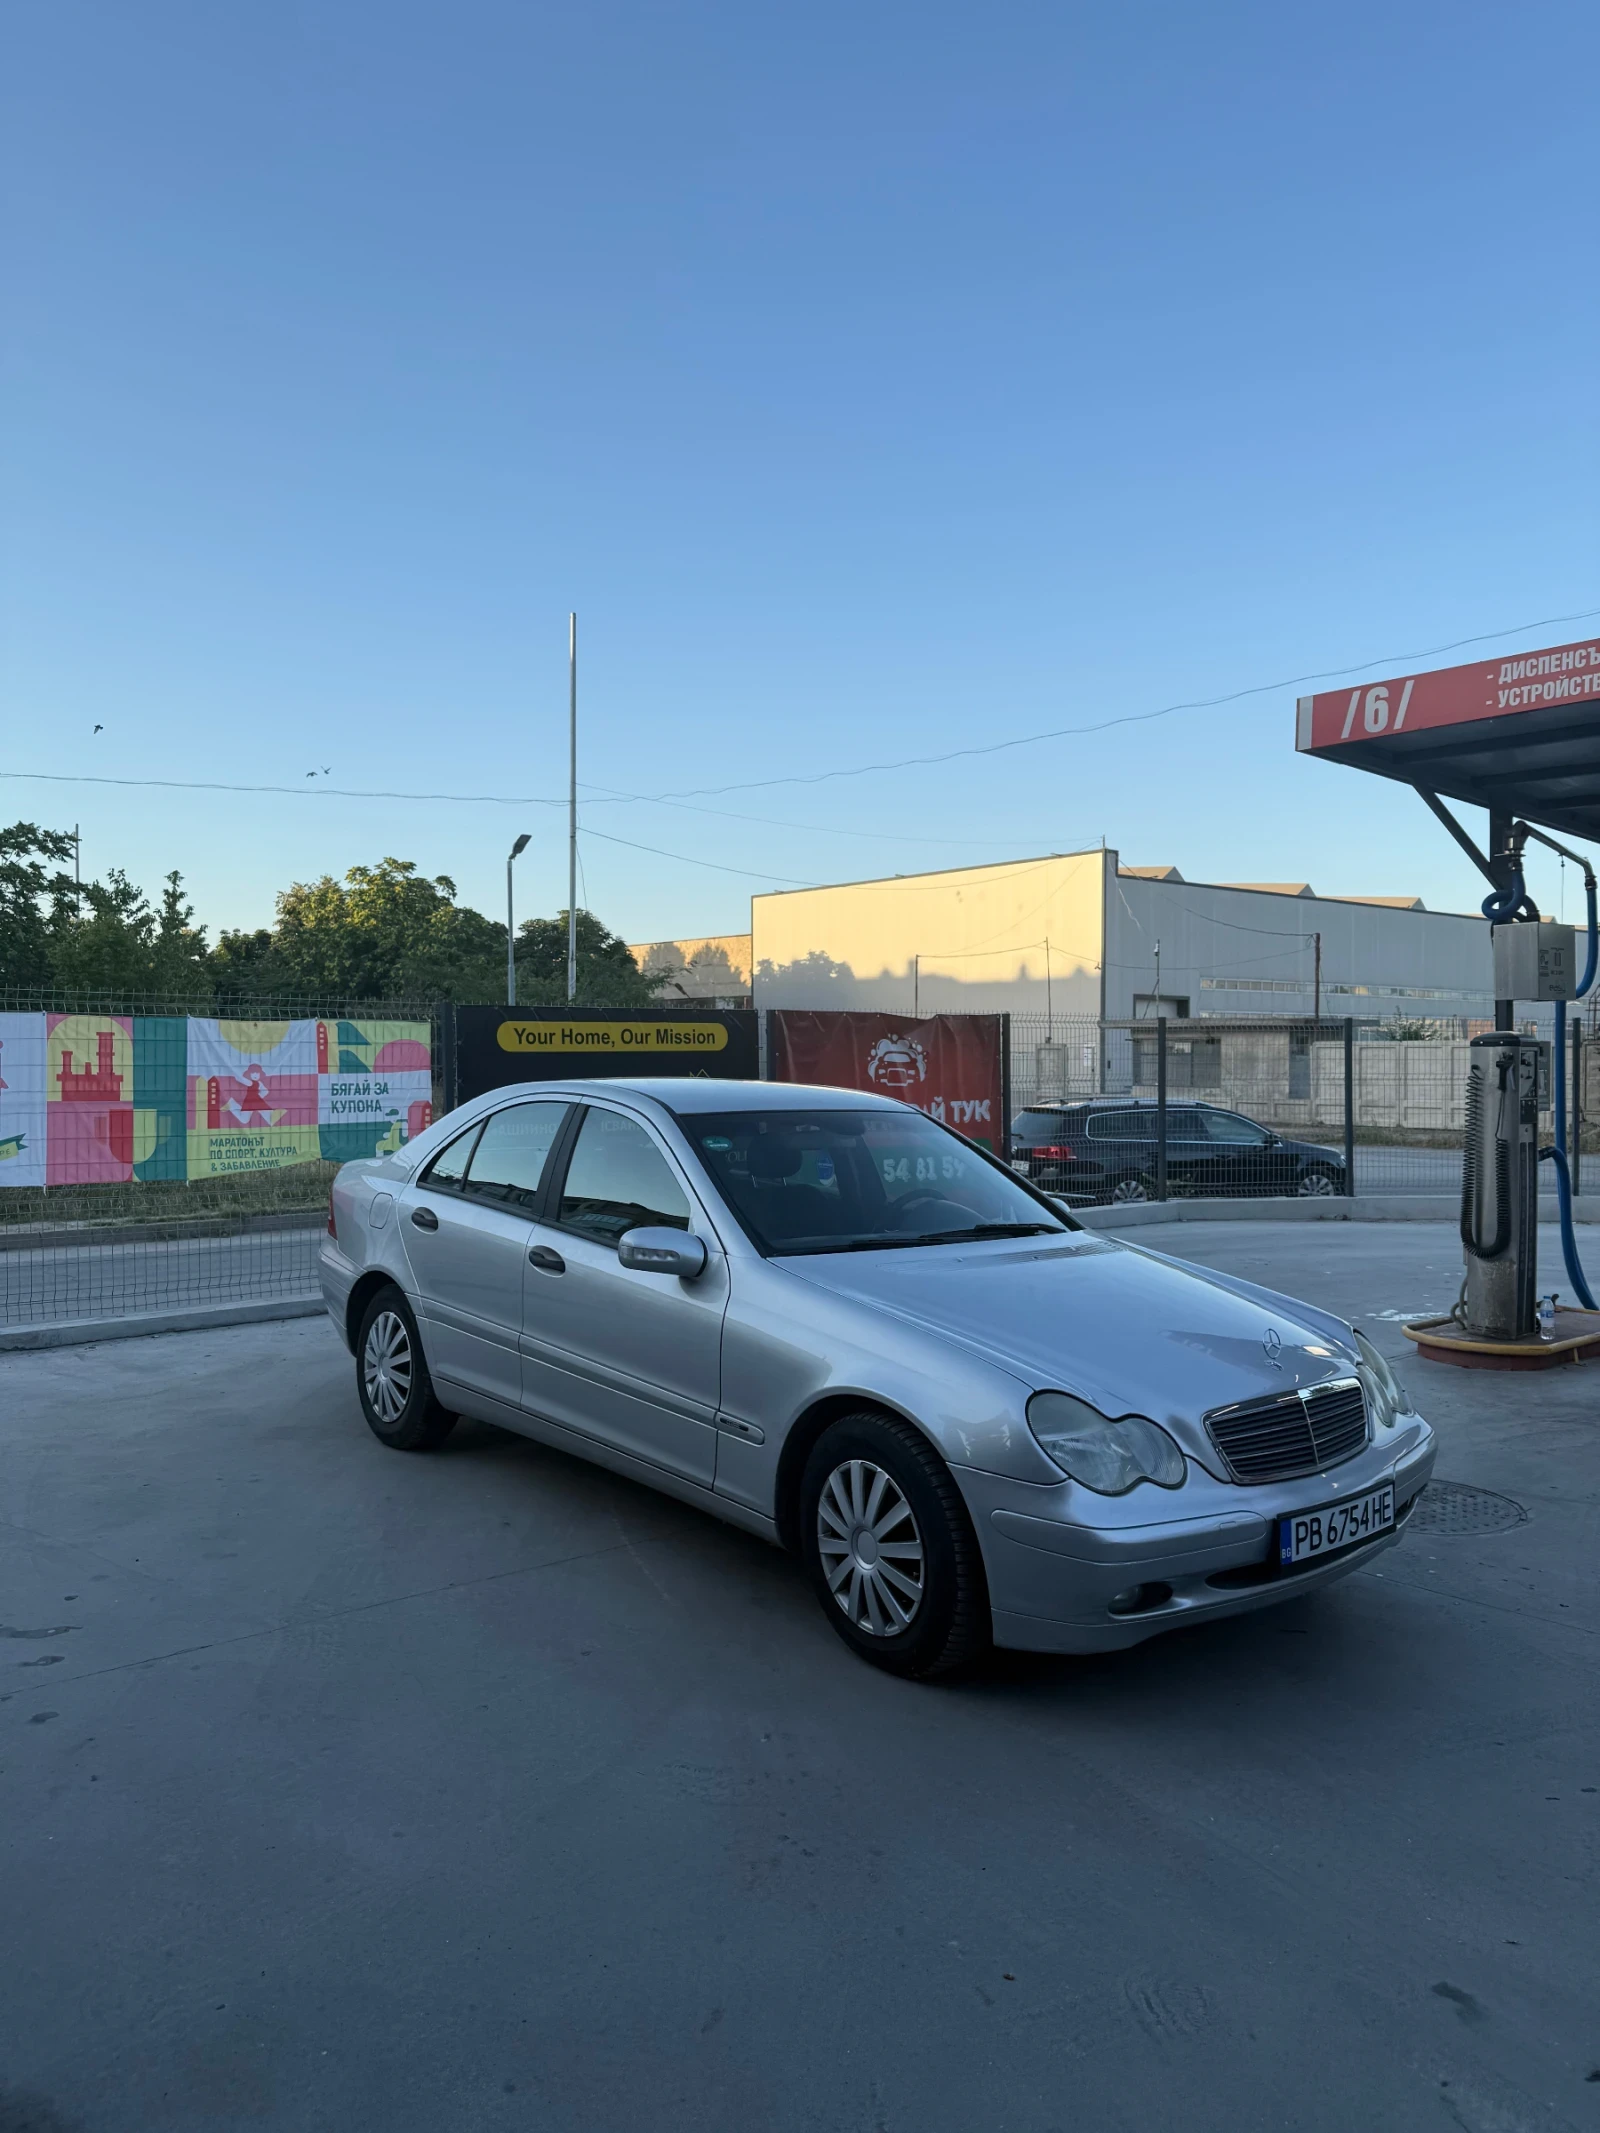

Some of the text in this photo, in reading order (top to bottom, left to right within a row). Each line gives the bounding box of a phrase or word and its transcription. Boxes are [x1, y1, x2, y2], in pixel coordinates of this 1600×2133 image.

[514, 1028, 716, 1048] Your Home, Our Mission
[331, 1079, 389, 1097] БЯГАЙ ЗА
[331, 1099, 383, 1114] КУПОНА
[950, 1099, 991, 1124] ТУК
[210, 1137, 265, 1147] МАРАТОНЪТ
[210, 1146, 298, 1159] ПО СПОРТ, КУЛТУРА
[211, 1159, 281, 1172] & ЗАБАВЛЕНИЕ
[883, 1157, 911, 1182] 54
[915, 1156, 938, 1181] 81
[1295, 1490, 1392, 1555] PB 6754 HE
[1281, 1547, 1292, 1559] BG
